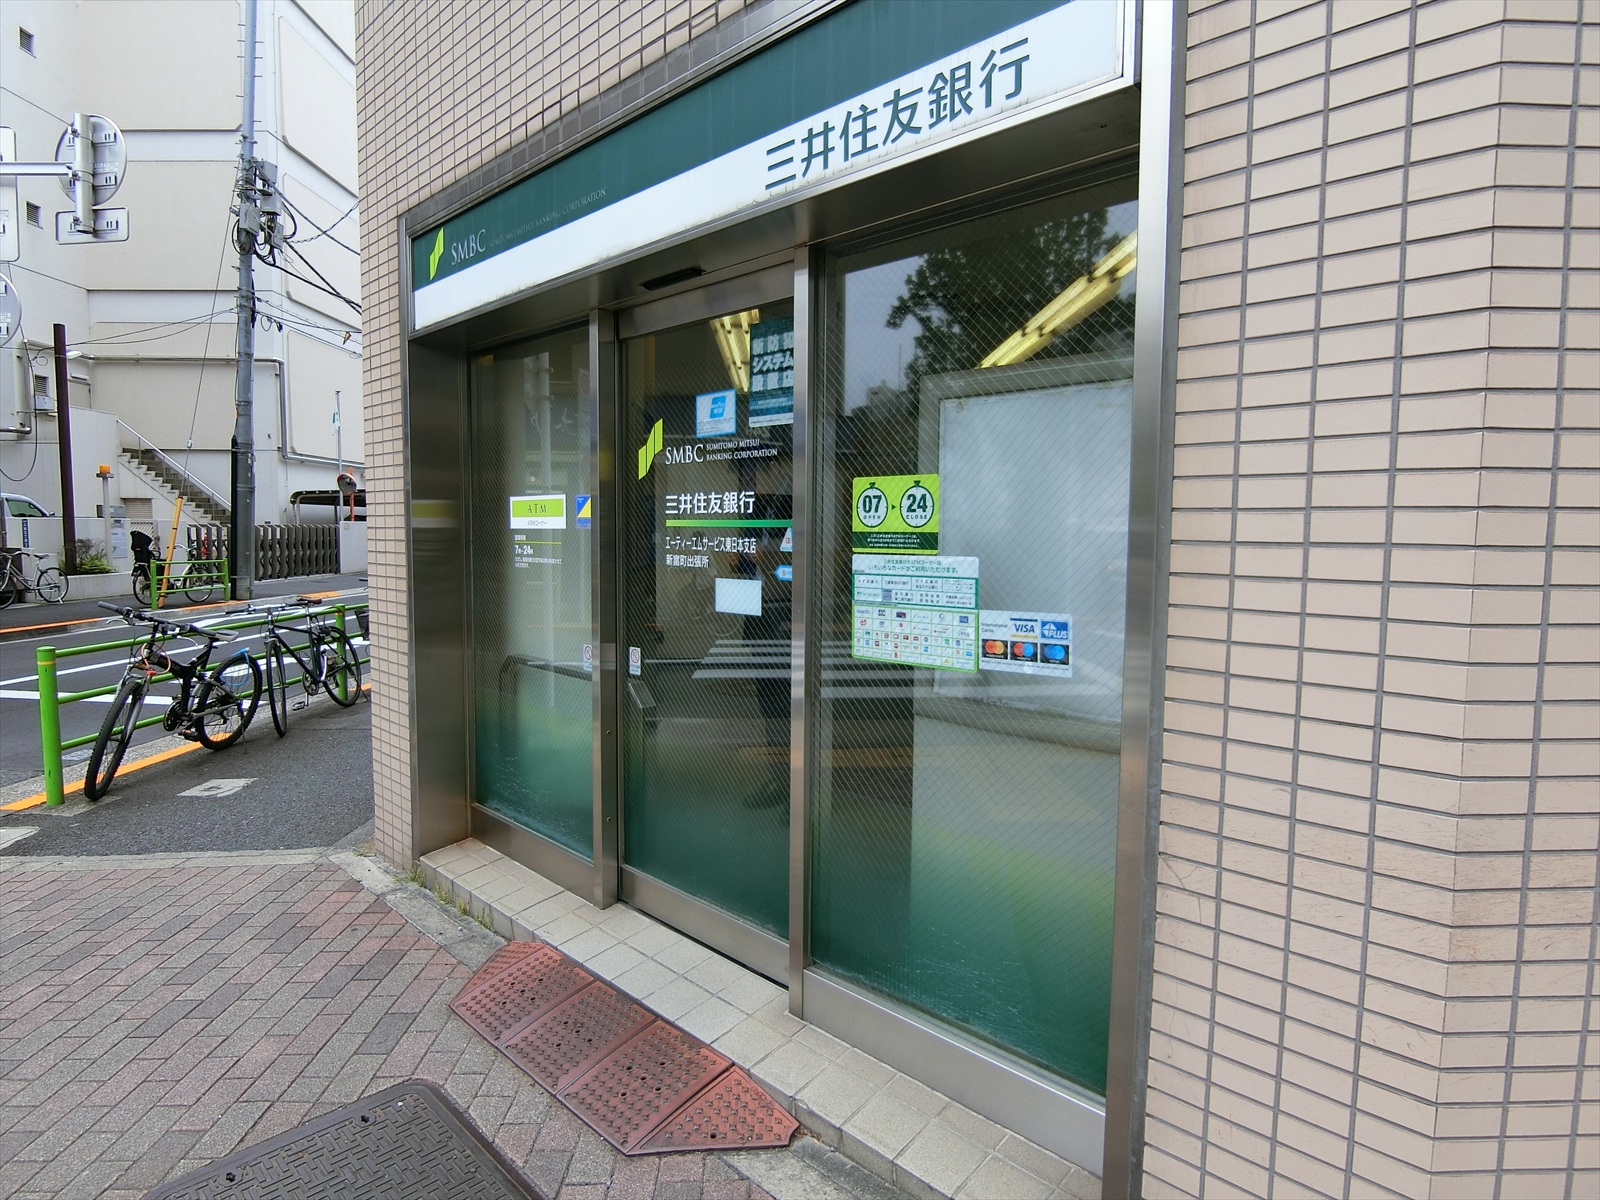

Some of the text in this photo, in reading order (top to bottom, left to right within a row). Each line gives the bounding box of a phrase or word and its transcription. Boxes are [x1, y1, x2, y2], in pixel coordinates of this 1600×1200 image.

[764, 37, 1030, 191] 三井住友銀行
[451, 229, 486, 266] SMBC
[562, 187, 607, 215] CORPORATION
[752, 350, 794, 374] システム
[706, 438, 760, 451] SUMITOMO MITSUI
[665, 444, 704, 465] SMBC
[706, 448, 778, 462] BANKING CORPORATION
[527, 503, 547, 514] ATM
[665, 491, 755, 515] 三井住友銀行
[862, 495, 882, 513] 07
[906, 493, 928, 513] 24
[665, 536, 757, 554] エーティーエムサービス東日本支店
[665, 553, 710, 568] 新富町出張所
[1014, 624, 1035, 633] VISA
[1049, 630, 1068, 639] PLUS
